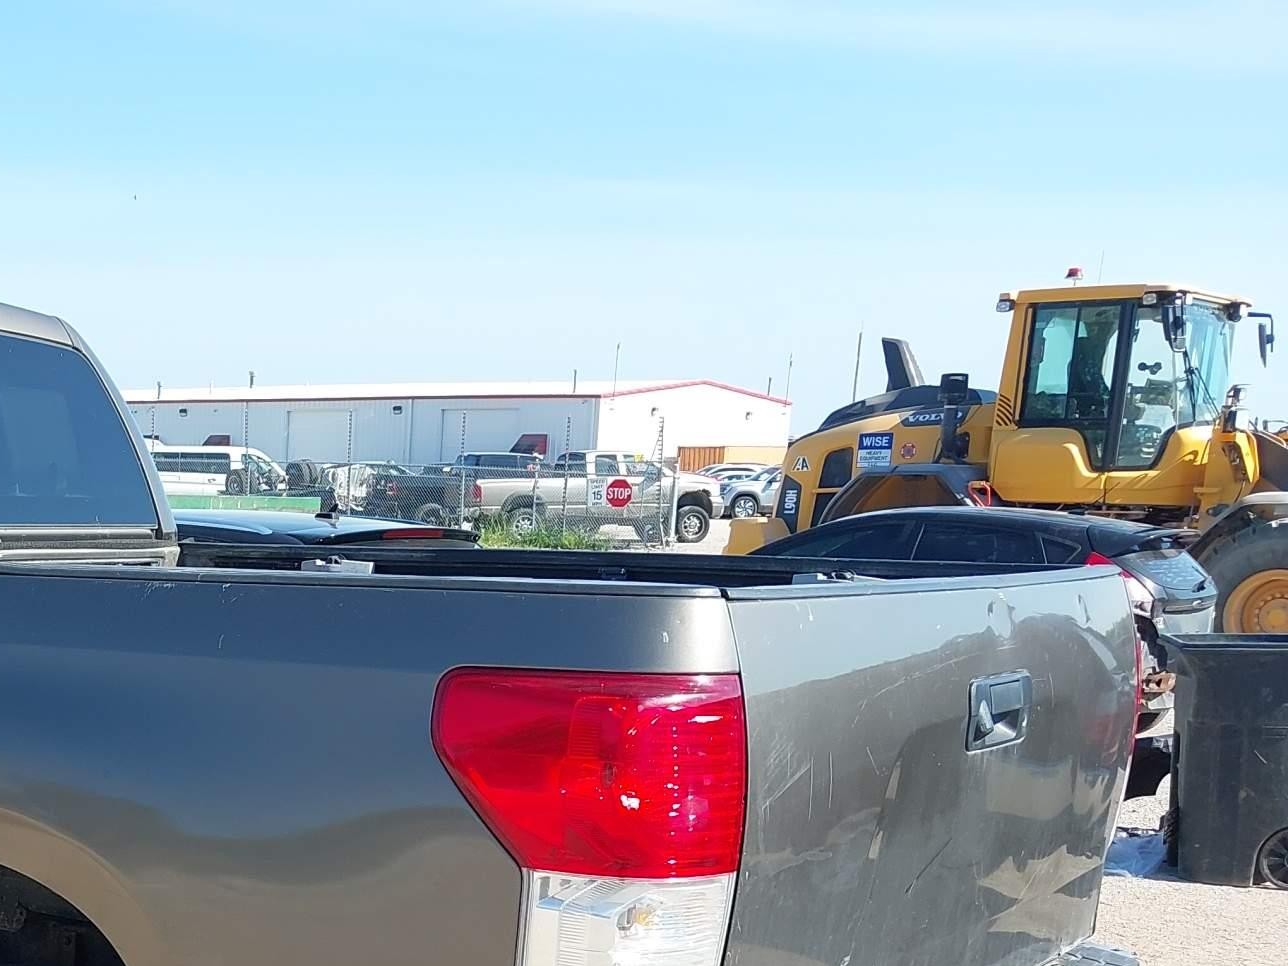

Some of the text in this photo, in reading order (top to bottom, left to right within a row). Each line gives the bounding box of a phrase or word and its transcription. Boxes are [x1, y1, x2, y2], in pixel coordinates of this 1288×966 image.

[908, 412, 963, 423] VOL
[862, 436, 890, 447] WISE
[592, 490, 603, 500] 15
[607, 487, 631, 499] STOP
[784, 490, 798, 514] L90H
